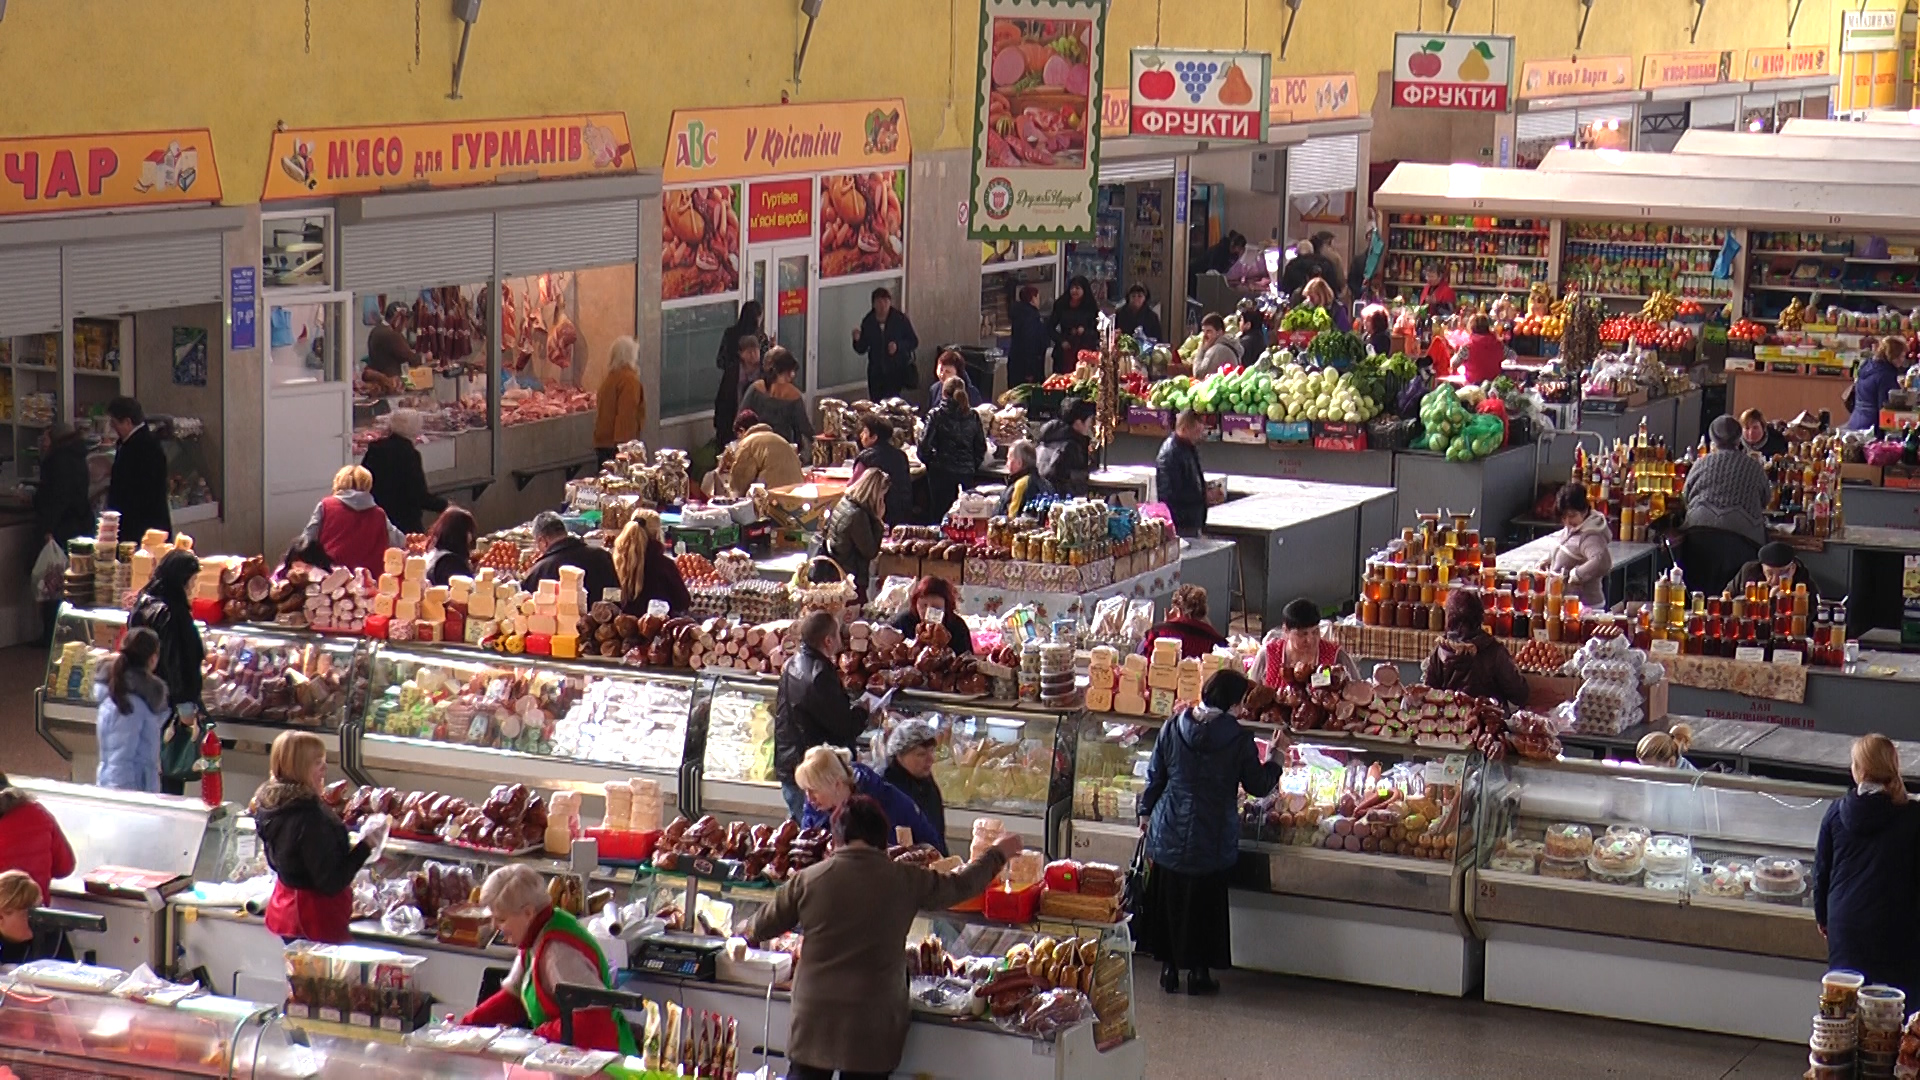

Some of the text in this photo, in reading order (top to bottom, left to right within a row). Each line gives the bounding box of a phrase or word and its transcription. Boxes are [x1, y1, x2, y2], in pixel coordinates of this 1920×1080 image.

[1286, 79, 1308, 104] РСС
[1403, 84, 1497, 107] ФРУКТИ
[1141, 110, 1249, 136] ФРУКТИ
[327, 126, 583, 180] М'ЯСО для ГУРМАНІВ
[676, 120, 718, 169] ABC
[743, 123, 842, 168] У Крістіни
[5, 147, 119, 200] ЧАР
[762, 191, 799, 210] Гуртівня
[750, 209, 808, 228] м'ясні вироби
[1828, 215, 1841, 224] 10
